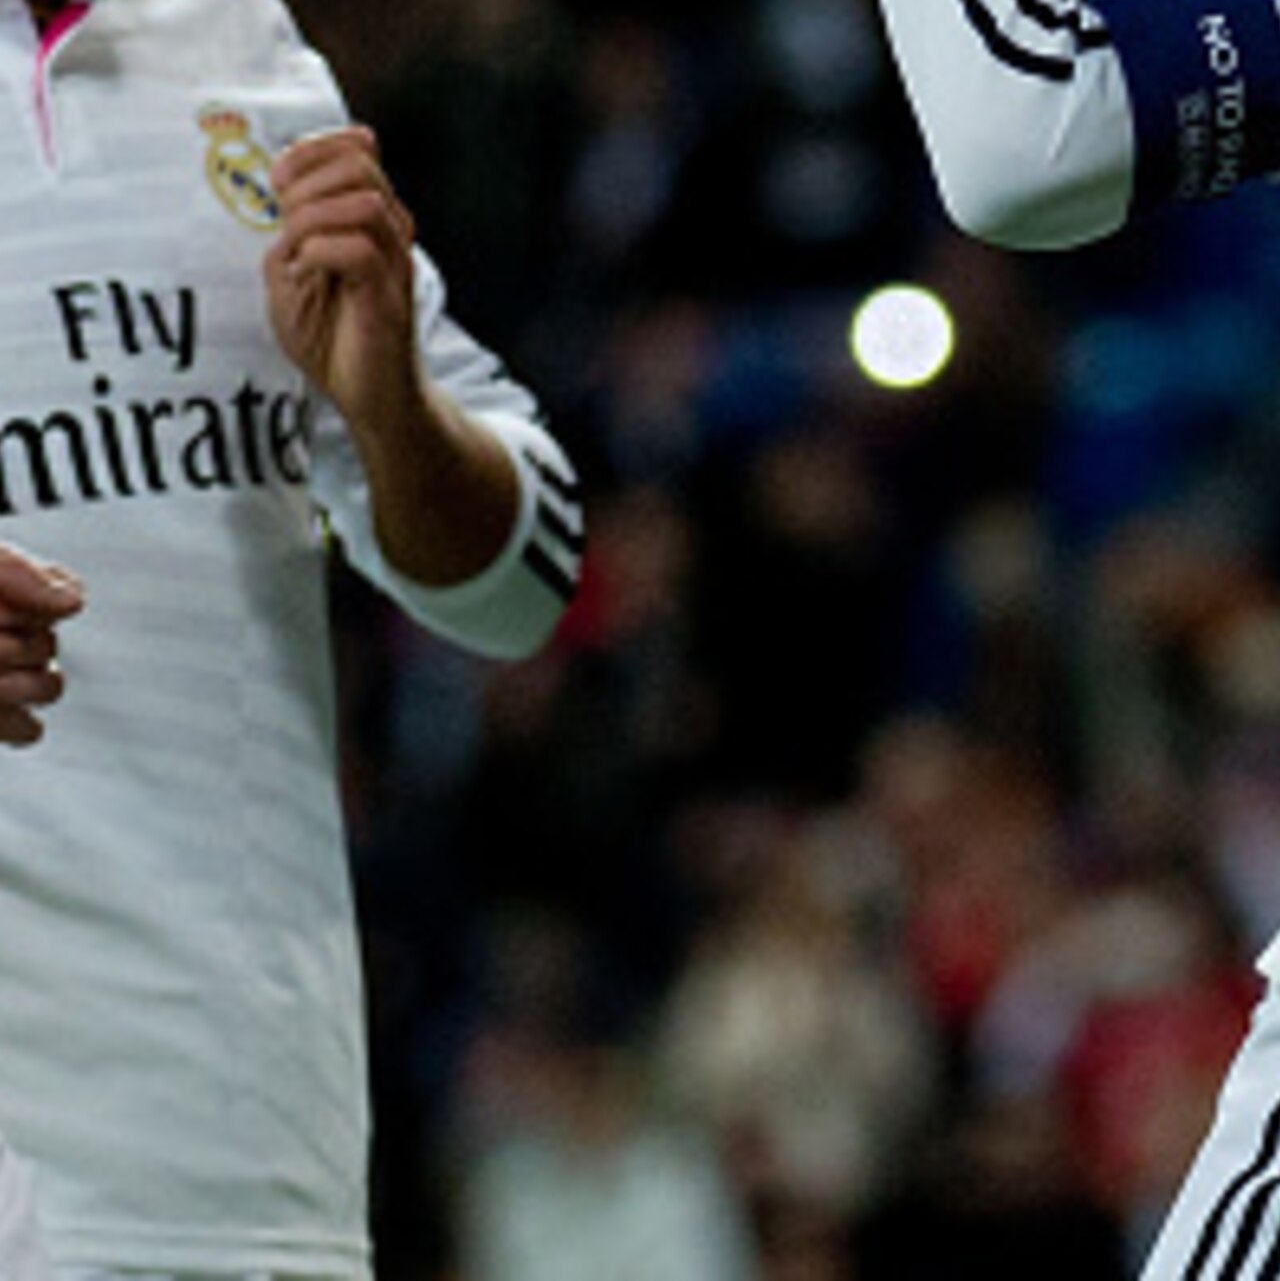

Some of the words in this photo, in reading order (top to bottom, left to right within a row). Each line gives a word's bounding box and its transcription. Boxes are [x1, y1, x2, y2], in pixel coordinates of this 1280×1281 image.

[1196, 13, 1240, 76] NO
[1216, 76, 1246, 129] TO
[53, 279, 195, 374] Fly
